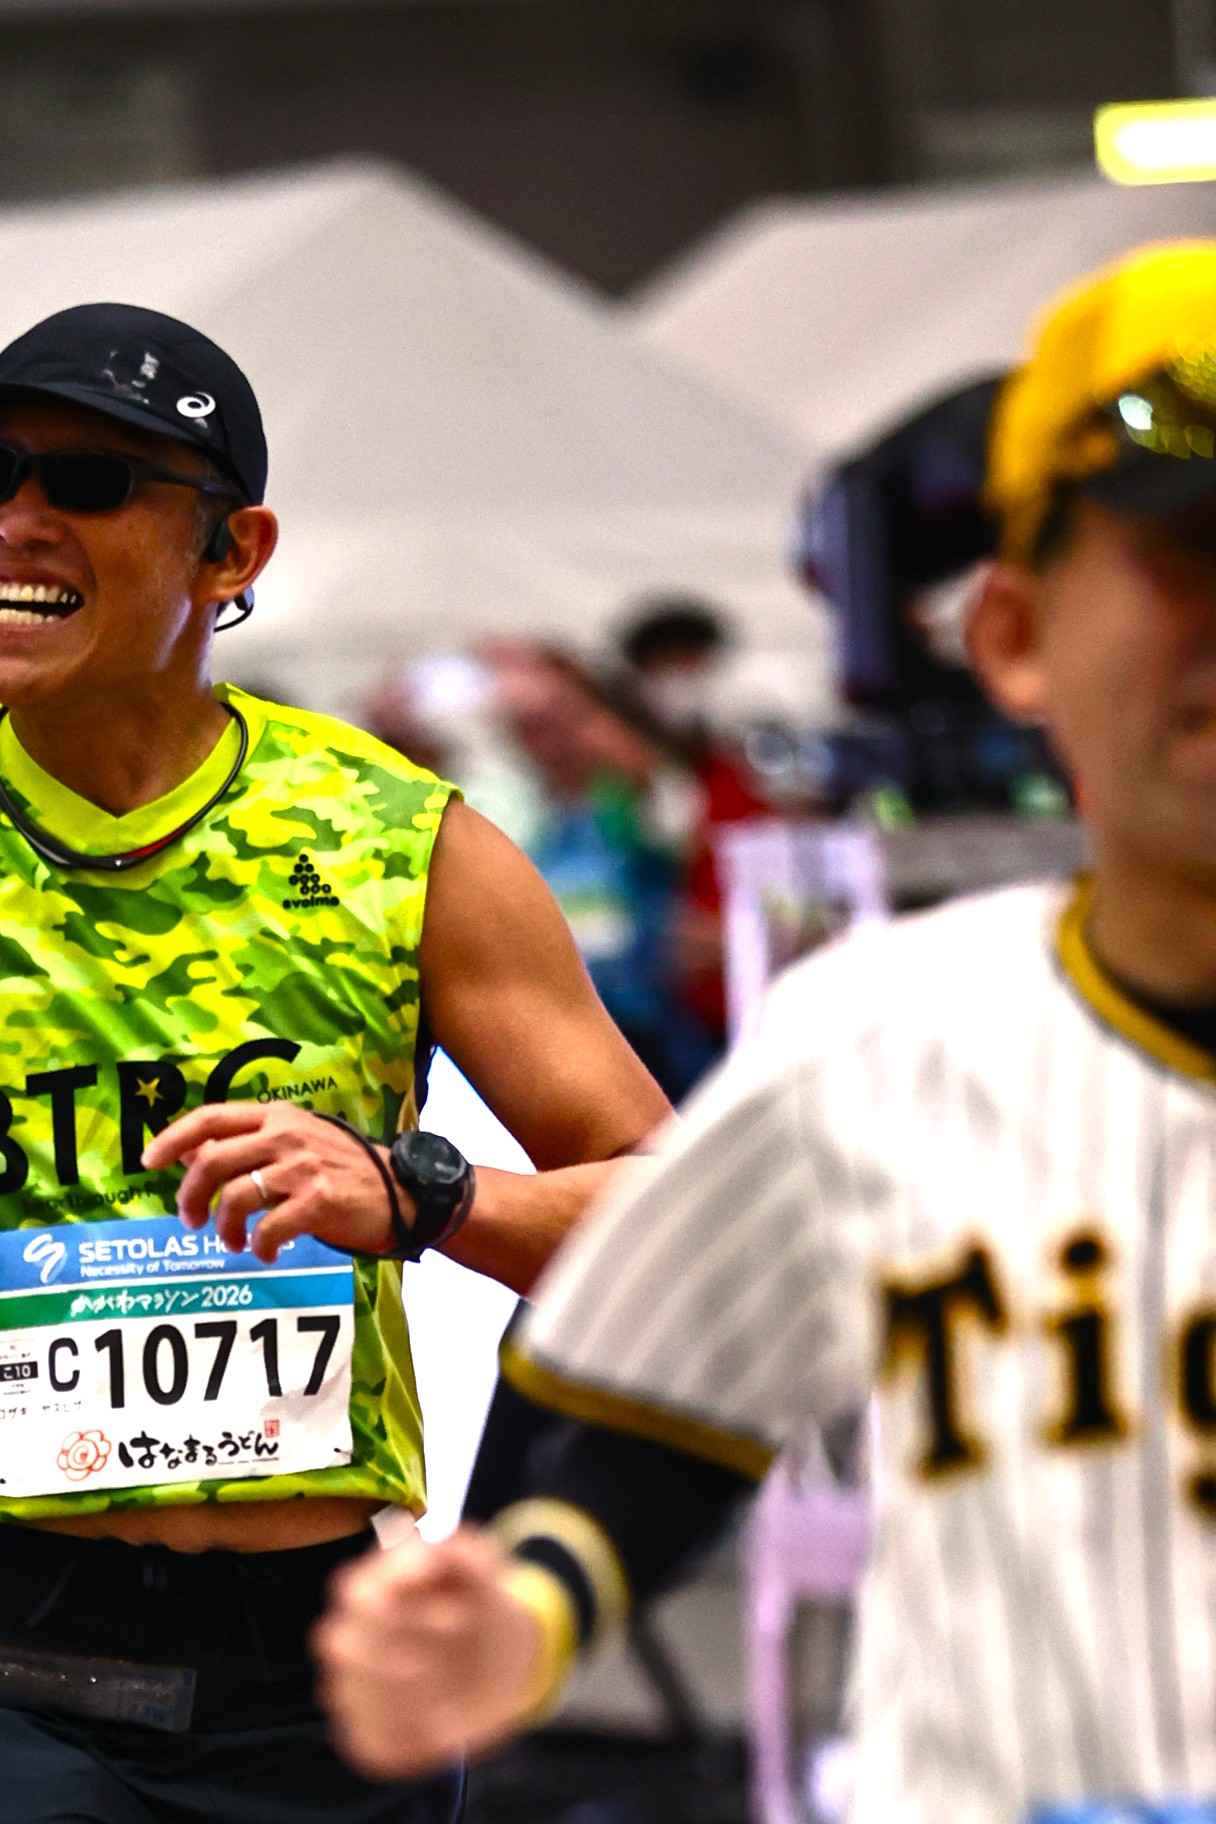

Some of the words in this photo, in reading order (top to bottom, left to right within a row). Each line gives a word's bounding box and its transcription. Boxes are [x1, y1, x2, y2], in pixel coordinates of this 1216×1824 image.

[256, 1075, 338, 1104] OKINAWA
[78, 1235, 199, 1264] SETOLAS
[80, 1261, 144, 1278] Necessity
[146, 1259, 161, 1273] of
[164, 1258, 226, 1273] Tomorrow
[118, 1430, 279, 1469] はなまるうどん
